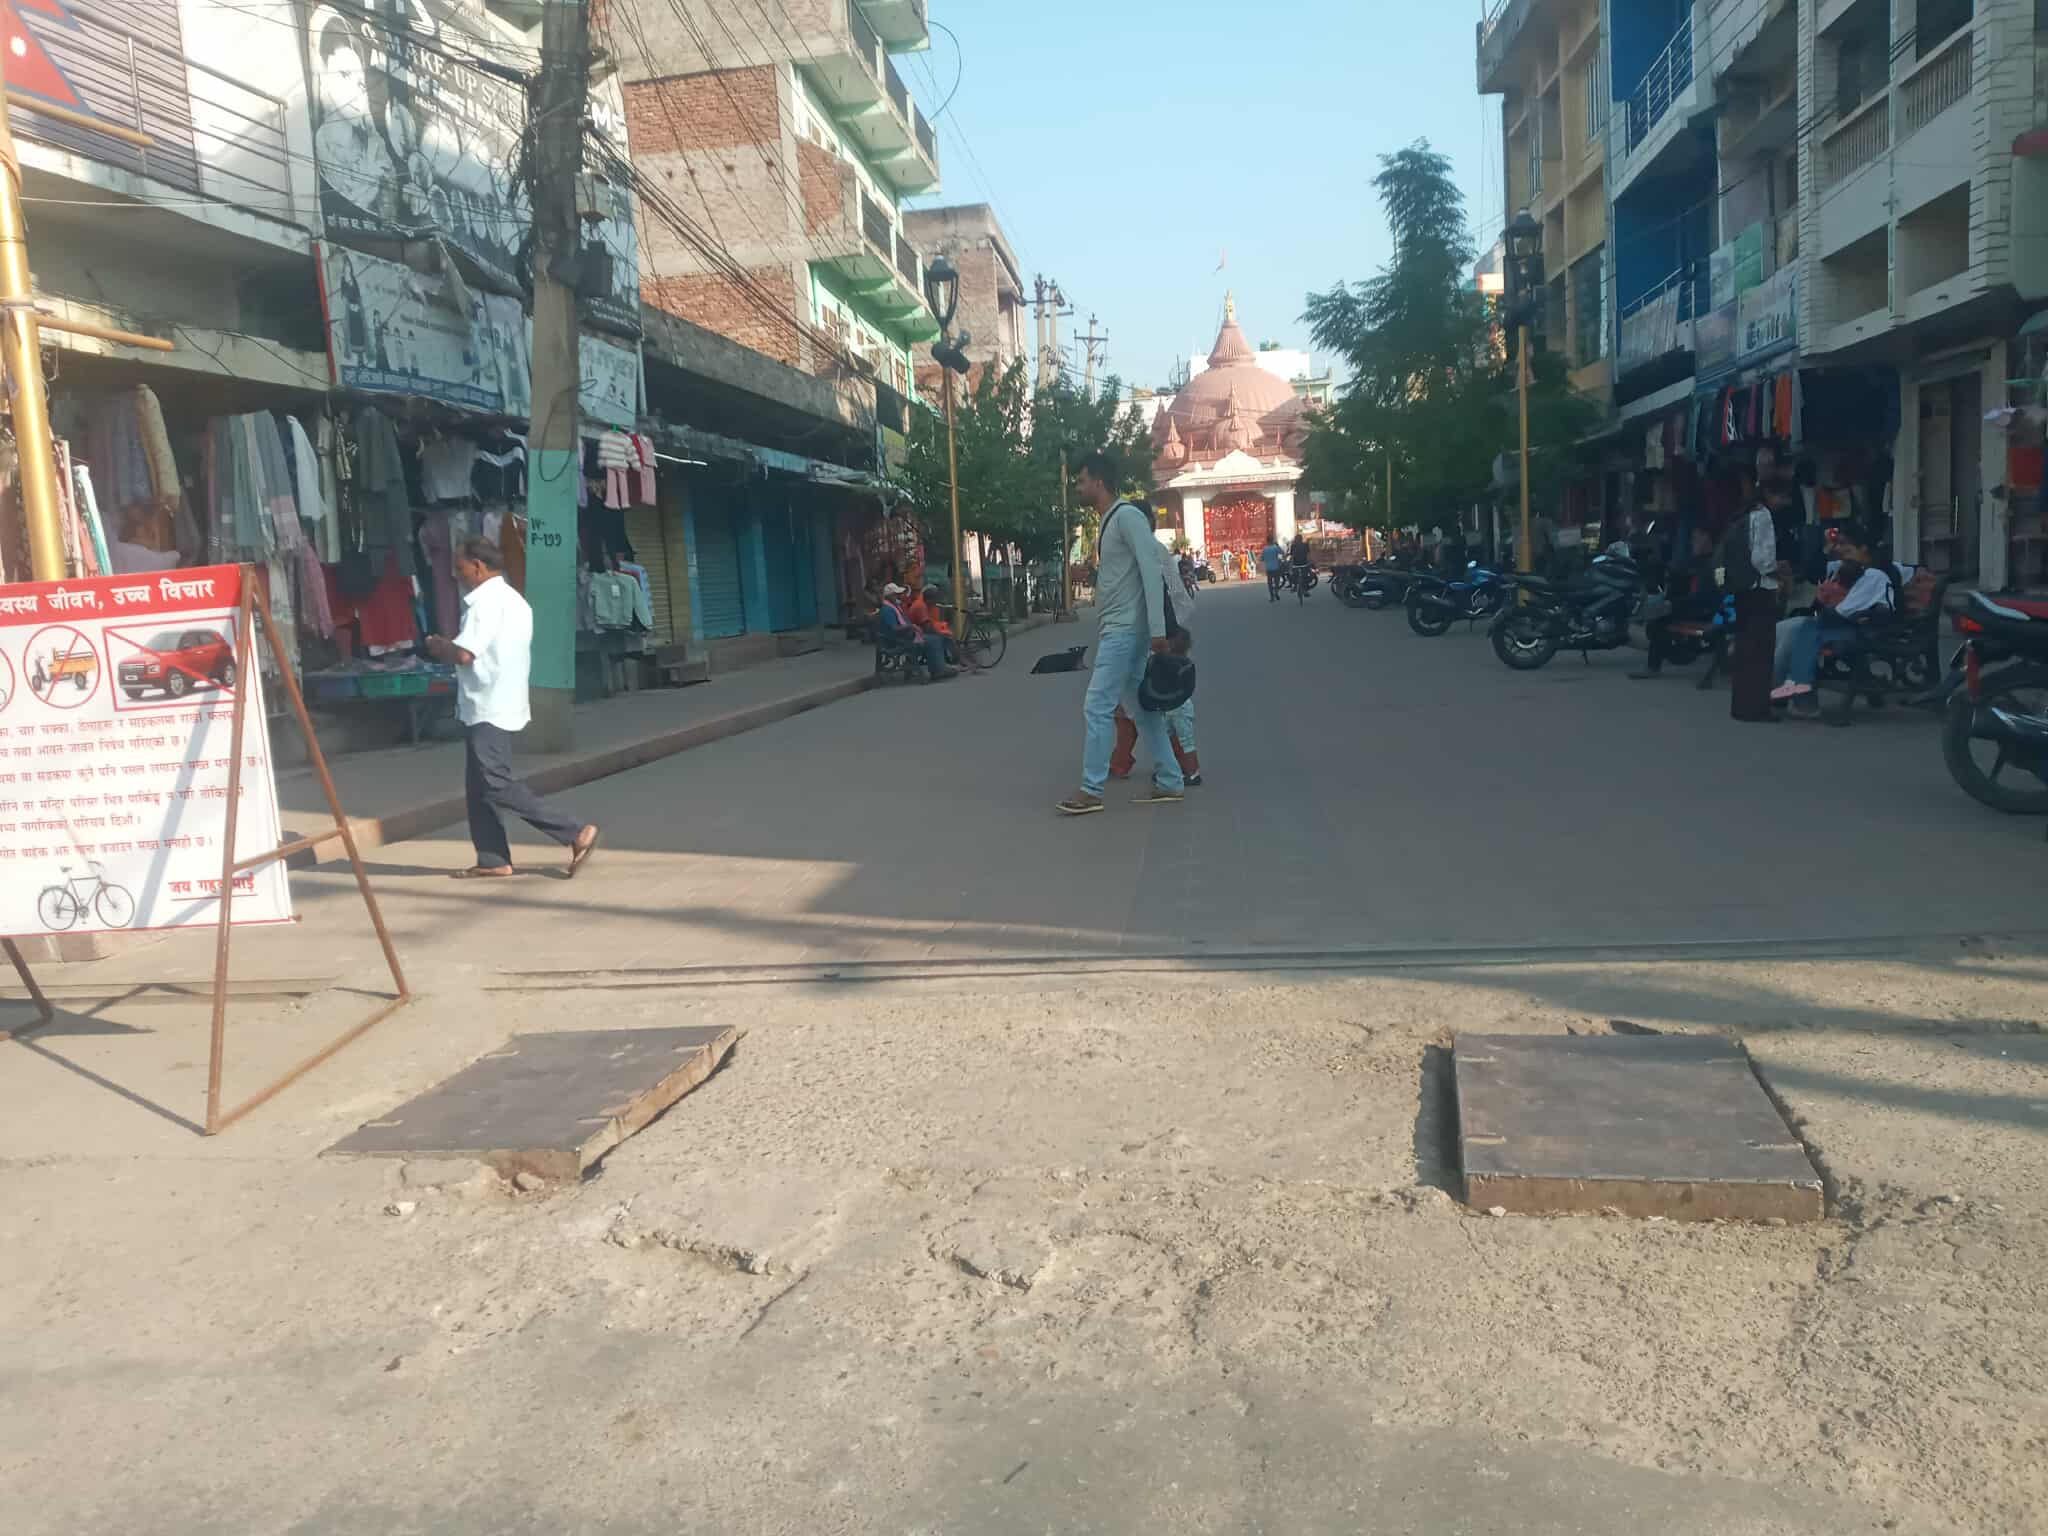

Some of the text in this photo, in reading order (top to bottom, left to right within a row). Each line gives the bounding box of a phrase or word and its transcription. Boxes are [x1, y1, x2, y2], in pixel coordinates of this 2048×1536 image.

[0, 578, 215, 615] वस्थ जीवन, उच्च विचार
[168, 872, 256, 895] जय गहमाई
